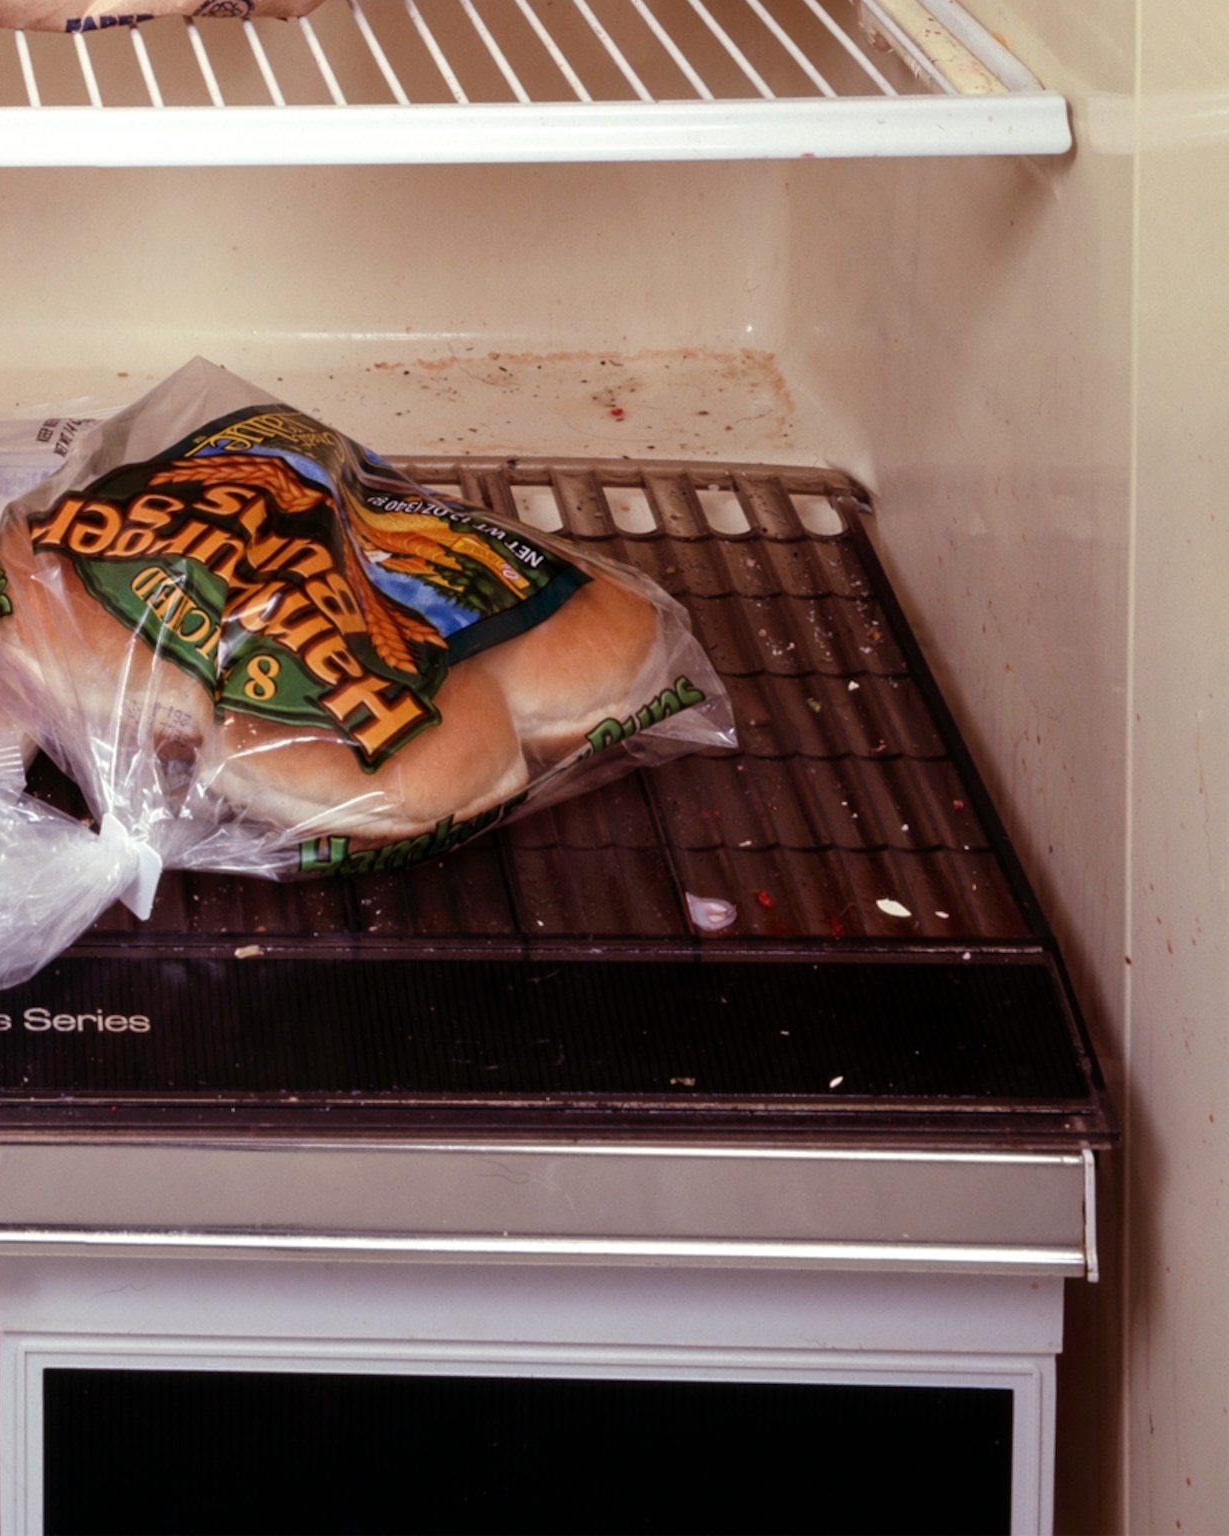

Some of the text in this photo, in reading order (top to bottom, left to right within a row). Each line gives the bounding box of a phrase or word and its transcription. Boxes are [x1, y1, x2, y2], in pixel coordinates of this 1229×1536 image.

[384, 500, 424, 513] (340
[421, 502, 449, 517] OZ
[192, 483, 368, 636] Buns
[503, 540, 545, 568] NET
[30, 494, 429, 758] Hamburger
[244, 654, 281, 702] 8
[23, 1007, 151, 1033] Series
